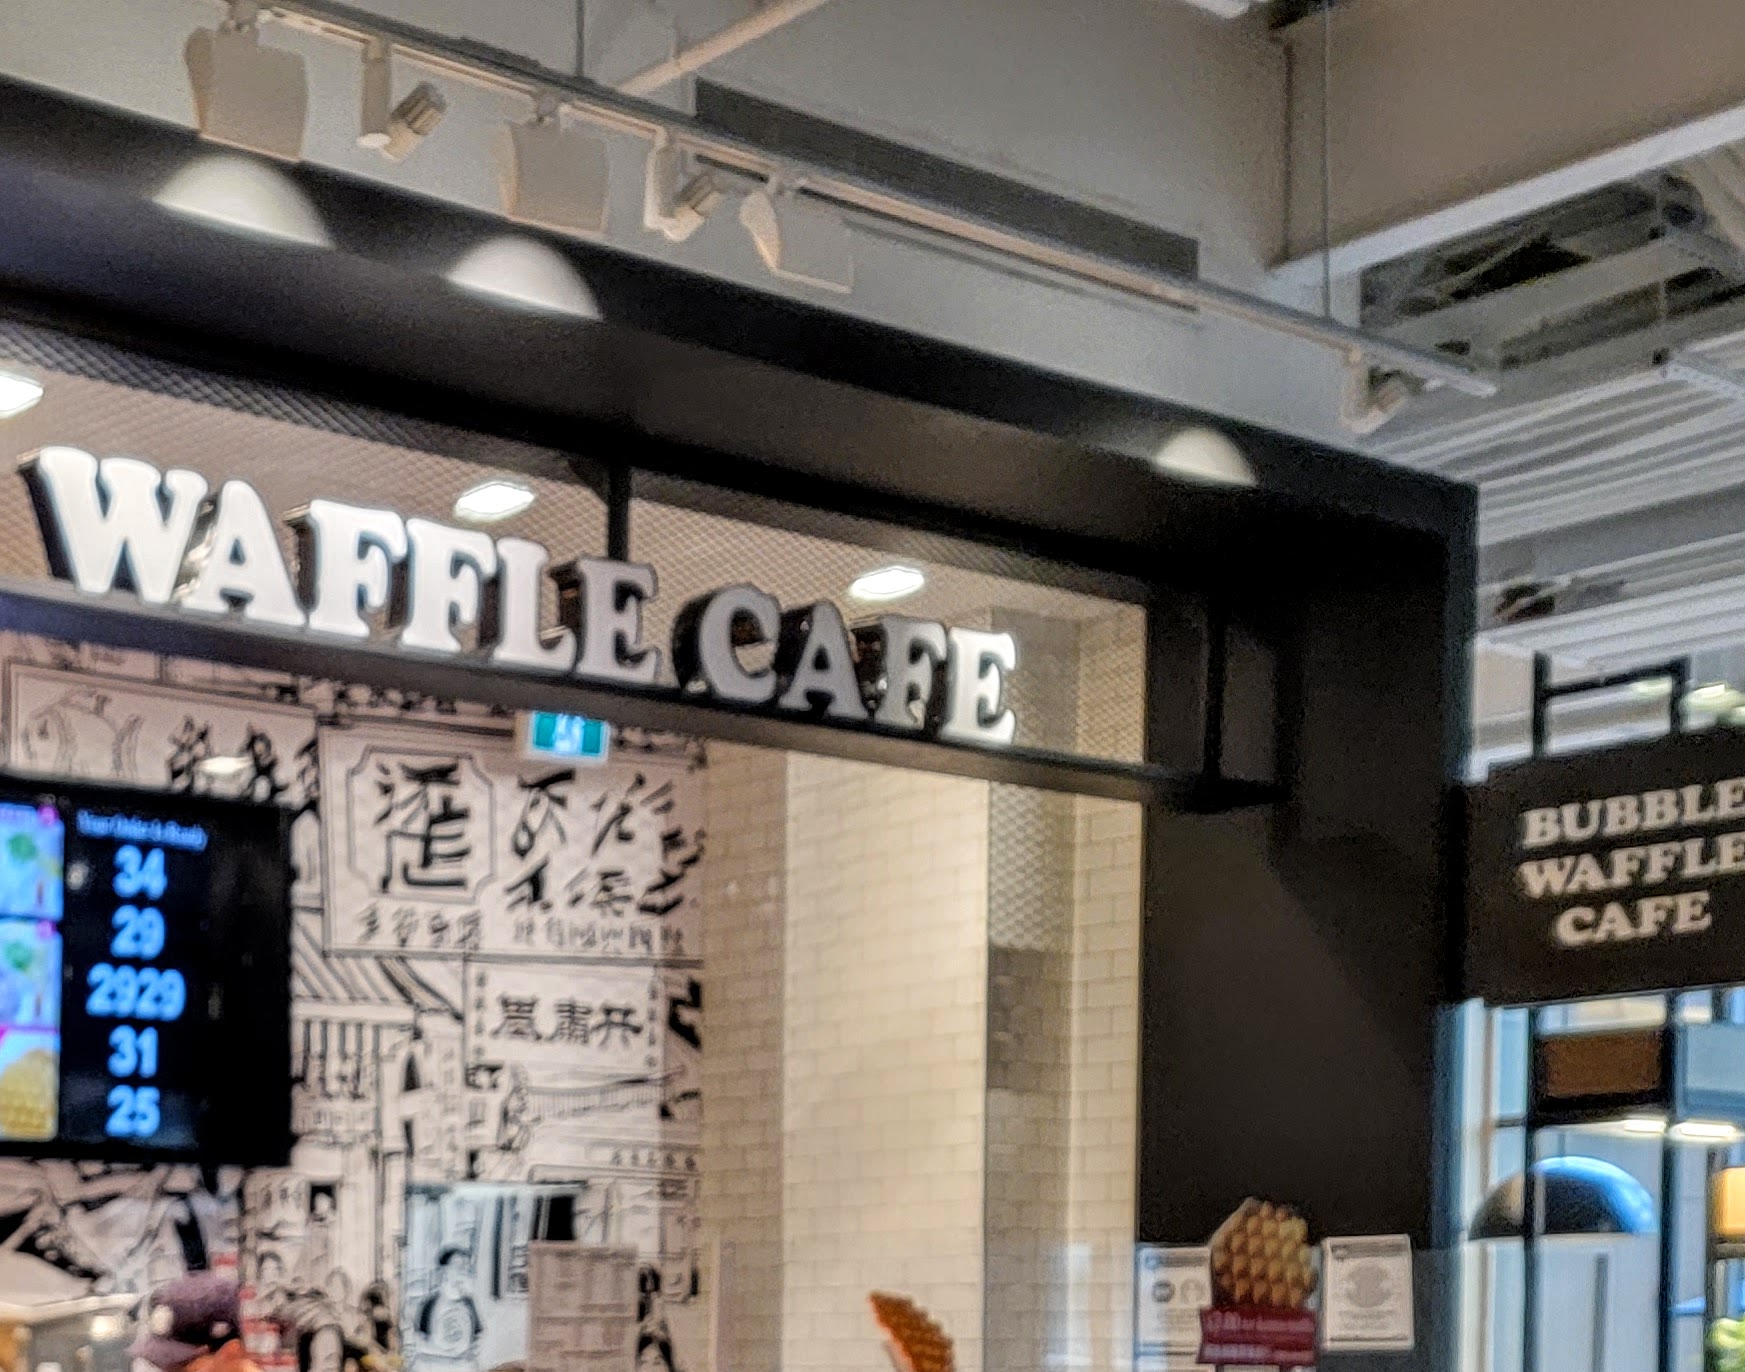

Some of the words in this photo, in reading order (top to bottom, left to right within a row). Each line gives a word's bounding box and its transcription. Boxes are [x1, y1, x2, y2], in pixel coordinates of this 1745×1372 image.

[24, 447, 662, 686] WAFFLE
[680, 582, 1017, 746] CAFE
[1518, 777, 1745, 849] BUBBLE
[113, 844, 168, 899] 34
[1516, 831, 1745, 899] WAFFLE
[110, 904, 165, 960] 29
[1553, 890, 1712, 948] CAFE
[85, 962, 187, 1022] 2929
[108, 1024, 160, 1078] 31
[106, 1084, 161, 1138] 25
